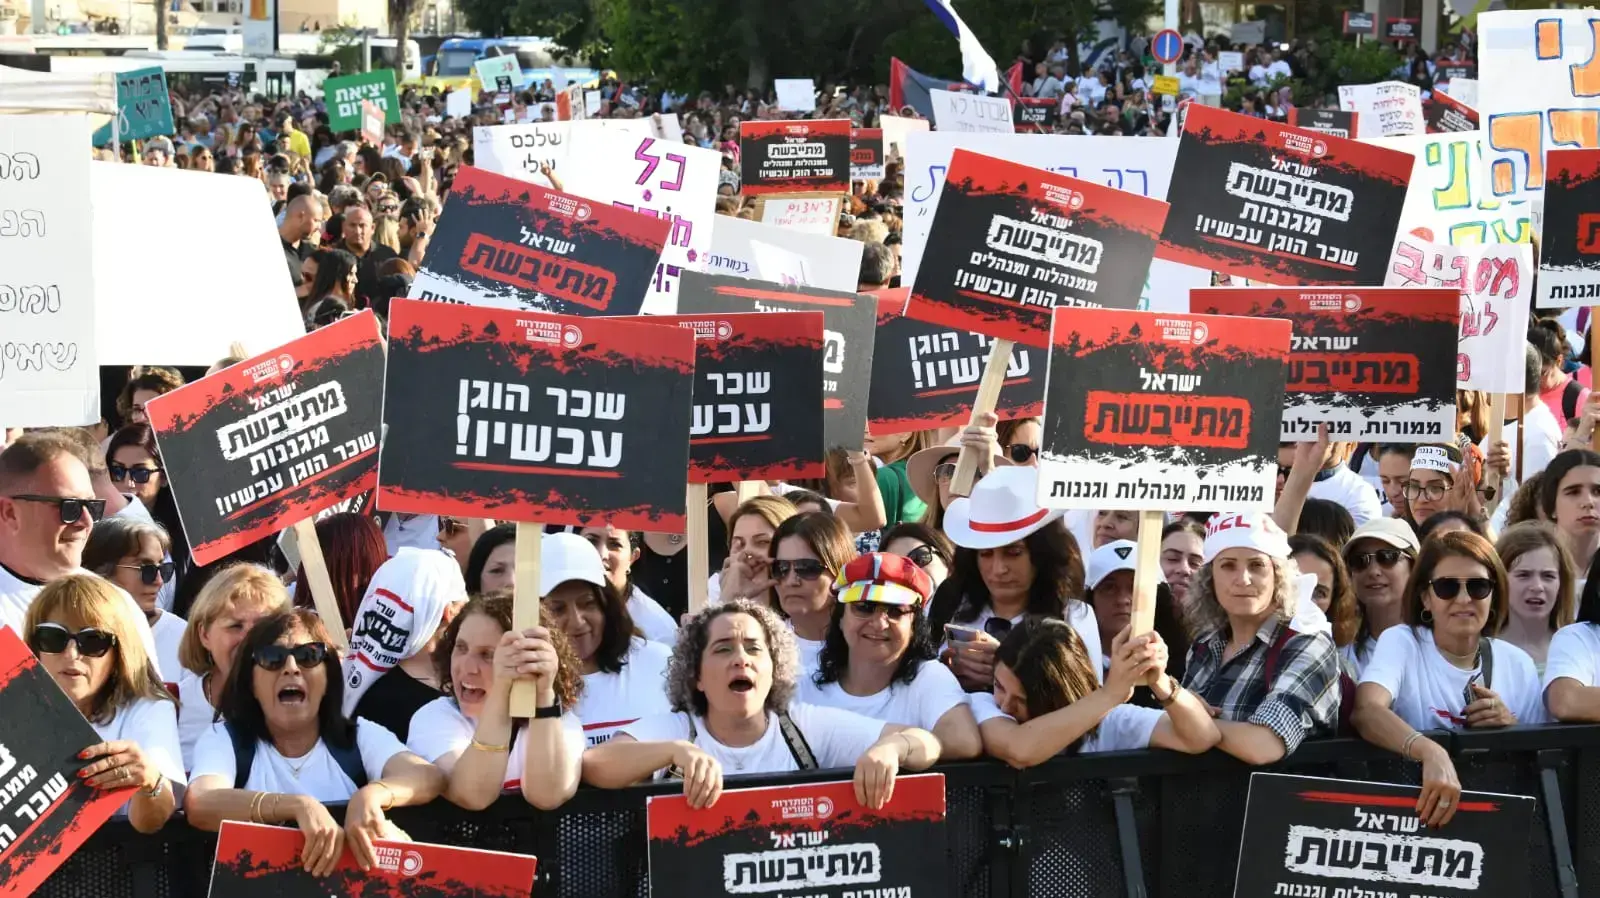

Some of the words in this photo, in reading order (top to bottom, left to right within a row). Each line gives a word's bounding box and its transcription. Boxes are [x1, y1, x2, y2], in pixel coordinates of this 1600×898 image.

[335, 82, 386, 103] יציאת
[511, 127, 562, 148] שלכם
[1279, 131, 1313, 143] הסתדרות
[1285, 138, 1312, 150] המורים
[771, 145, 823, 156] מתייבשת
[635, 137, 686, 191] כל
[793, 169, 810, 178] הוגן
[813, 168, 834, 176] שכר
[1271, 155, 1318, 177] ישראל
[543, 193, 578, 207] הסתדרות
[1040, 183, 1072, 194] הסתדרות
[1233, 170, 1348, 214] מתייבשת
[549, 200, 576, 212] המורים
[1030, 207, 1073, 229] ישראל
[1194, 214, 1263, 244] עכשיו!
[1239, 202, 1322, 236] מגננות
[519, 226, 576, 254] ישראל
[993, 222, 1098, 266] מתייבשת
[1267, 232, 1308, 256] הוגן
[708, 255, 750, 273] במורות
[970, 252, 1029, 276] ומנהלים
[1316, 243, 1359, 266] שכר
[468, 243, 608, 301] מתייבשת
[953, 269, 1018, 299] עכשיו!
[1032, 266, 1098, 293] ממנהלות
[1020, 288, 1058, 308] הוגן
[1551, 284, 1600, 300] וגננות
[516, 319, 562, 331] הסתדרות
[1154, 319, 1193, 328] הסתדרות
[1459, 301, 1499, 337] לש
[526, 327, 561, 339] המורים
[1162, 327, 1192, 336] המורים
[1289, 333, 1358, 350] ישראל
[909, 331, 960, 361] הוגן
[912, 350, 1030, 389] עשיו!
[1139, 367, 1202, 392] ישראל
[1288, 360, 1411, 385] מתייבש
[706, 371, 771, 396] שכר
[249, 383, 297, 411] ישראל
[458, 379, 530, 414] הוגן
[546, 387, 626, 421] שכר
[227, 387, 341, 453] מתייבשת
[690, 402, 771, 434] עכש
[1093, 402, 1244, 438] מתייבשת
[1359, 420, 1442, 436] ממורות,
[250, 425, 330, 476] מגננות
[332, 432, 377, 461] שכר
[456, 414, 623, 468] עכשיו!
[289, 453, 329, 487] הוגן
[216, 473, 284, 516] עכשיו!
[1050, 480, 1108, 499] וגננות
[1115, 477, 1186, 500] מנהלות
[1192, 484, 1264, 503] ממורות,
[15, 772, 69, 822] שכר
[772, 797, 814, 809] הסתדרות
[782, 805, 814, 814] המורים
[770, 831, 829, 849] ישראל
[733, 850, 873, 887] מתייבשת
[1295, 836, 1474, 879] מתייבשת
[1274, 882, 1327, 898] וגננות
